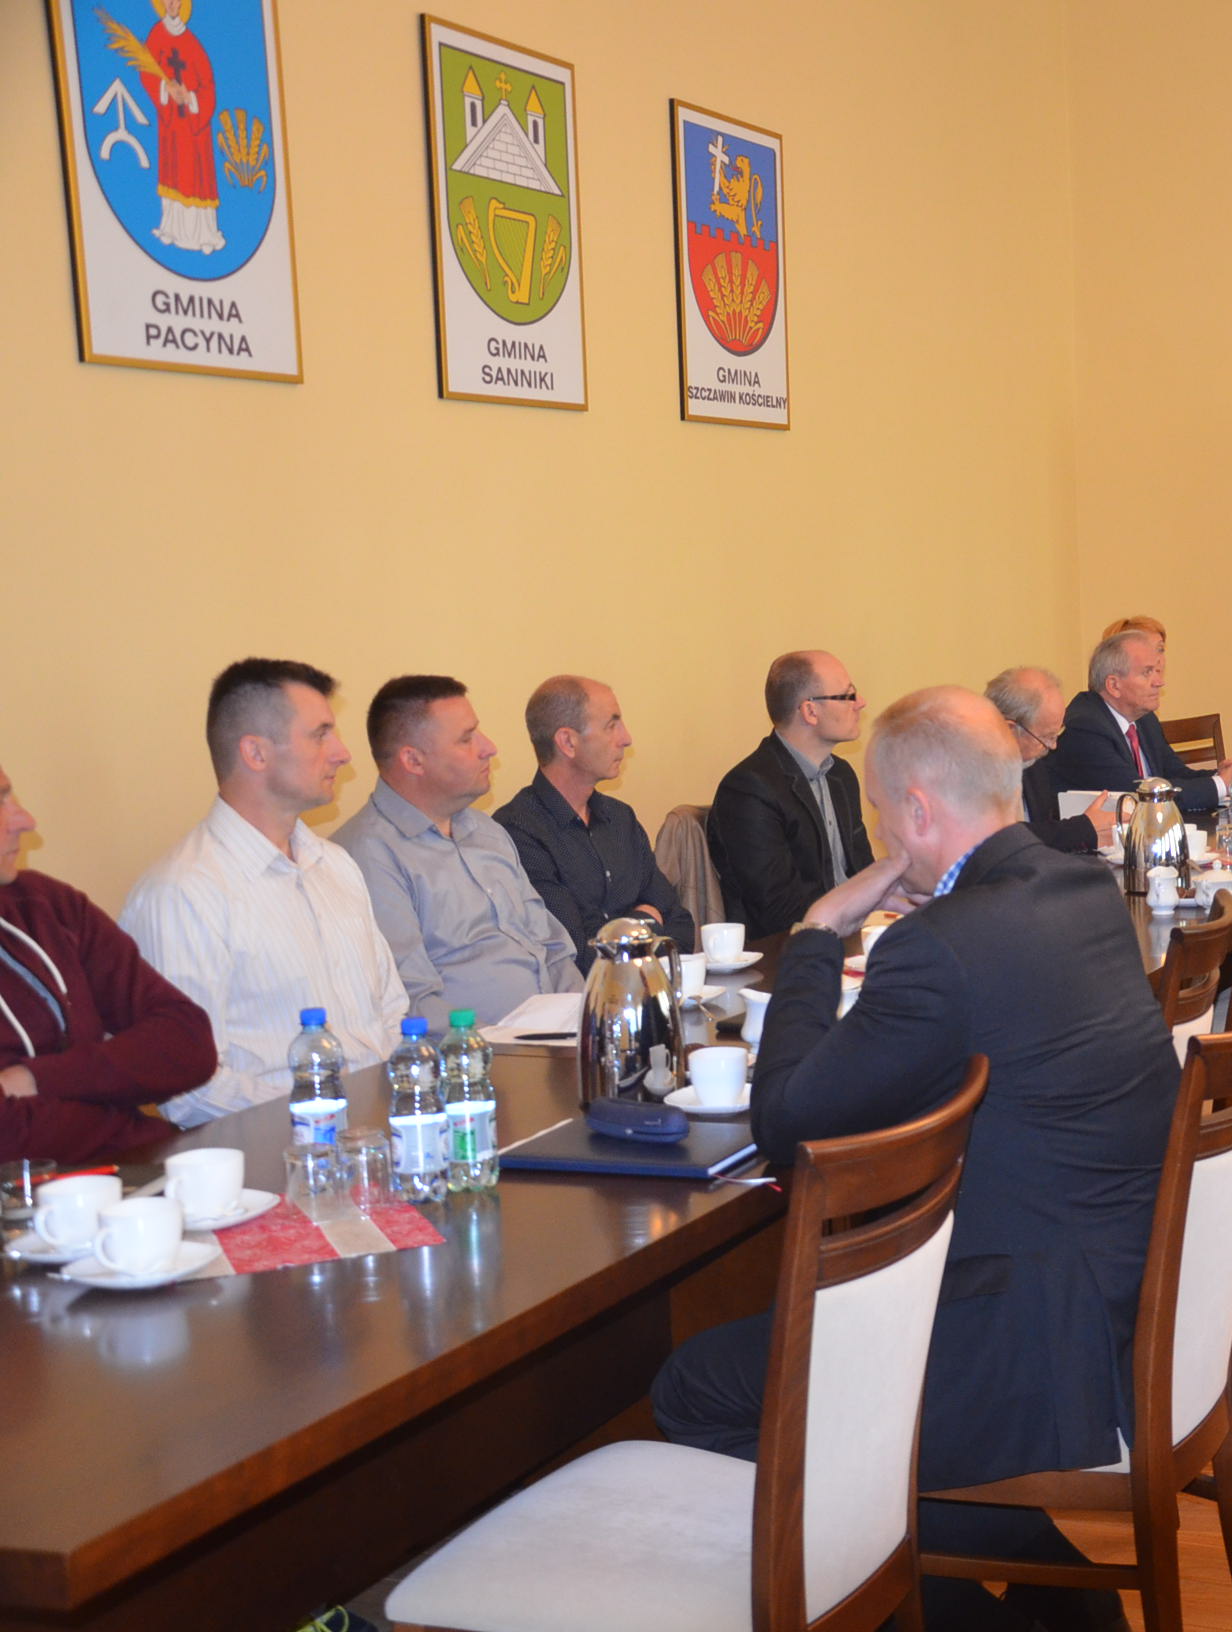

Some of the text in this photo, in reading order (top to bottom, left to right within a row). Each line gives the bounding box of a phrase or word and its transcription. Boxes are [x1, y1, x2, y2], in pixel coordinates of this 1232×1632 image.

[151, 290, 243, 324] GMINA
[145, 322, 253, 358] PACYNA
[487, 337, 548, 363] GMINA
[481, 364, 554, 391] SANNIKI
[716, 366, 761, 388] GMINA
[687, 385, 788, 410] SZCZAWIN KOŚCIELNY
